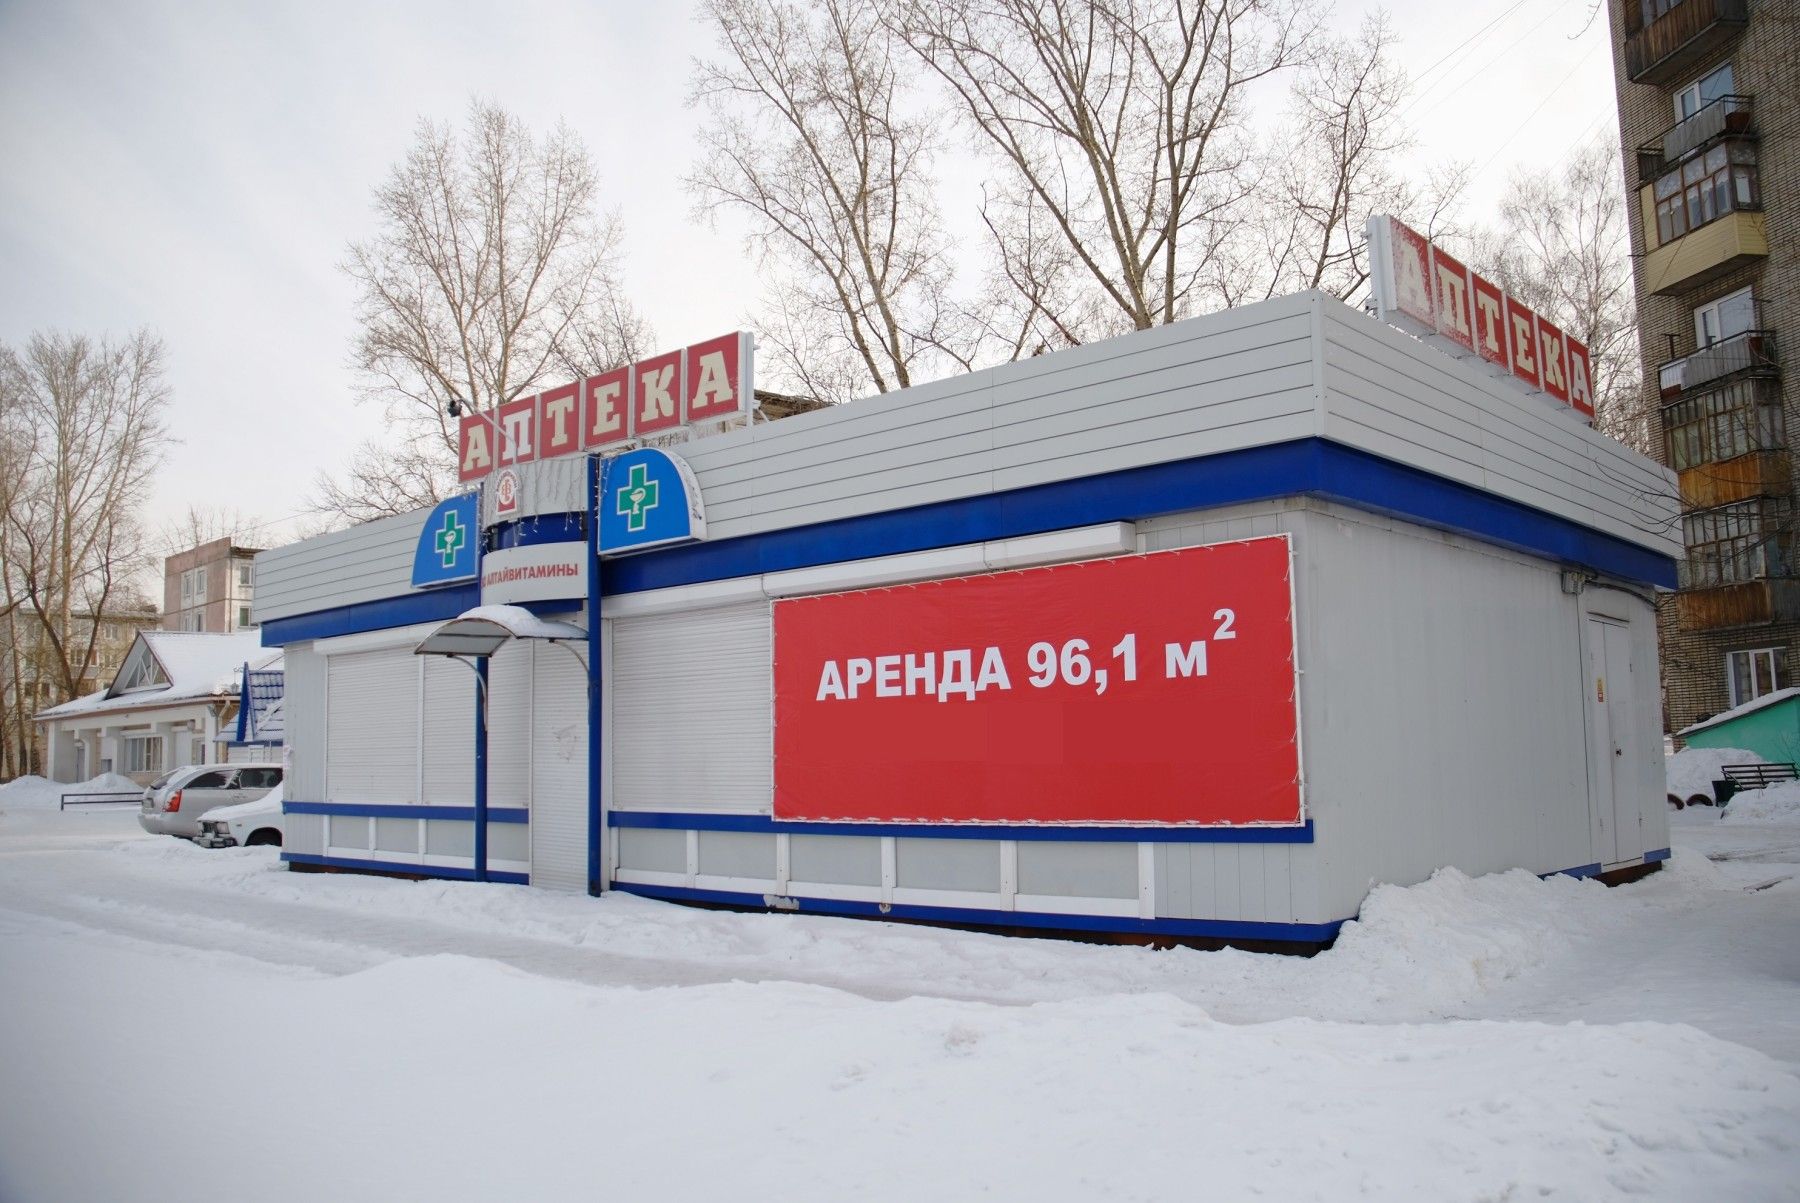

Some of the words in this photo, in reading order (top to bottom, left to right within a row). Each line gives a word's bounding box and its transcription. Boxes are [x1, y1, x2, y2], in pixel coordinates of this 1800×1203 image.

[1397, 243, 1592, 407] АПТЕКА
[462, 350, 734, 472] АПТЕКА
[816, 646, 1012, 703] АРЕНДА
[1027, 633, 1137, 696] 96,1
